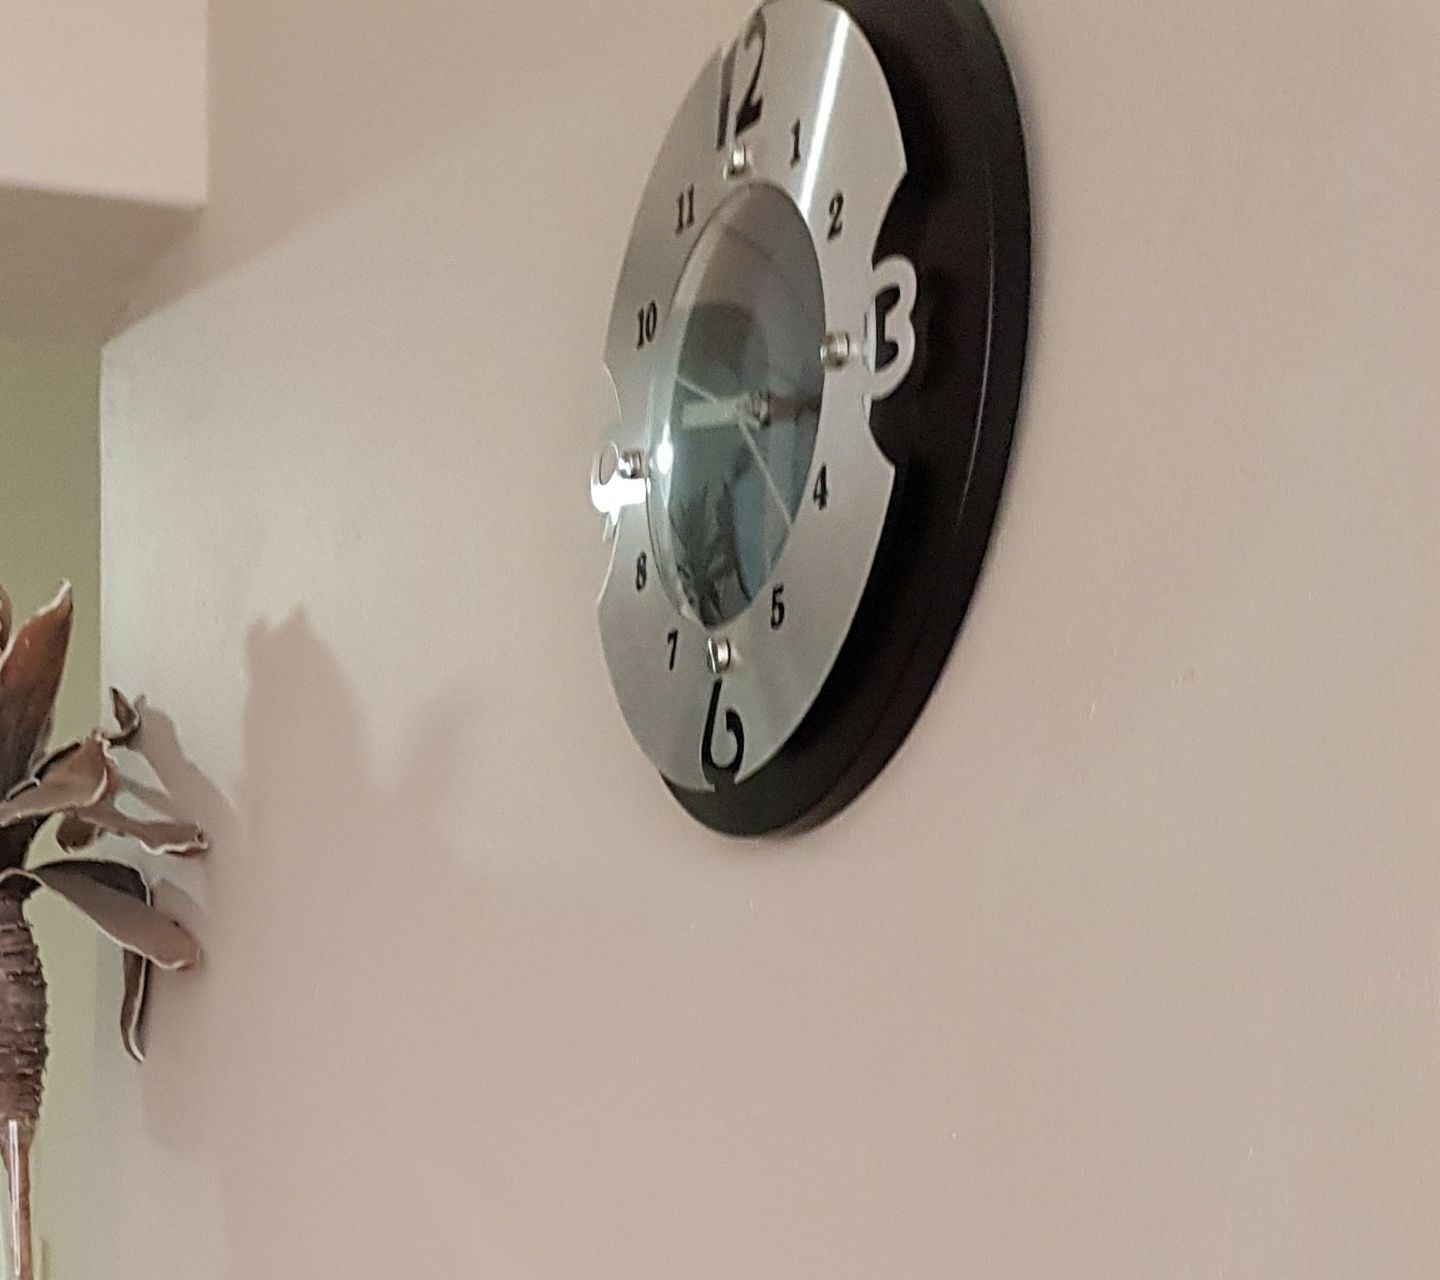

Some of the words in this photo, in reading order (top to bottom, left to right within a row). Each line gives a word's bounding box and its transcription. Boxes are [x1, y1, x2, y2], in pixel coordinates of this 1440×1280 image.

[716, 6, 766, 152] 12
[789, 118, 801, 168] 1
[675, 182, 695, 235] 11
[827, 191, 844, 241] 2
[636, 300, 657, 350] 10
[864, 254, 918, 401] 3
[813, 463, 828, 510] 4
[636, 552, 647, 591] 8
[770, 583, 785, 630] 5
[667, 630, 678, 671] 7
[701, 677, 744, 786] 6
